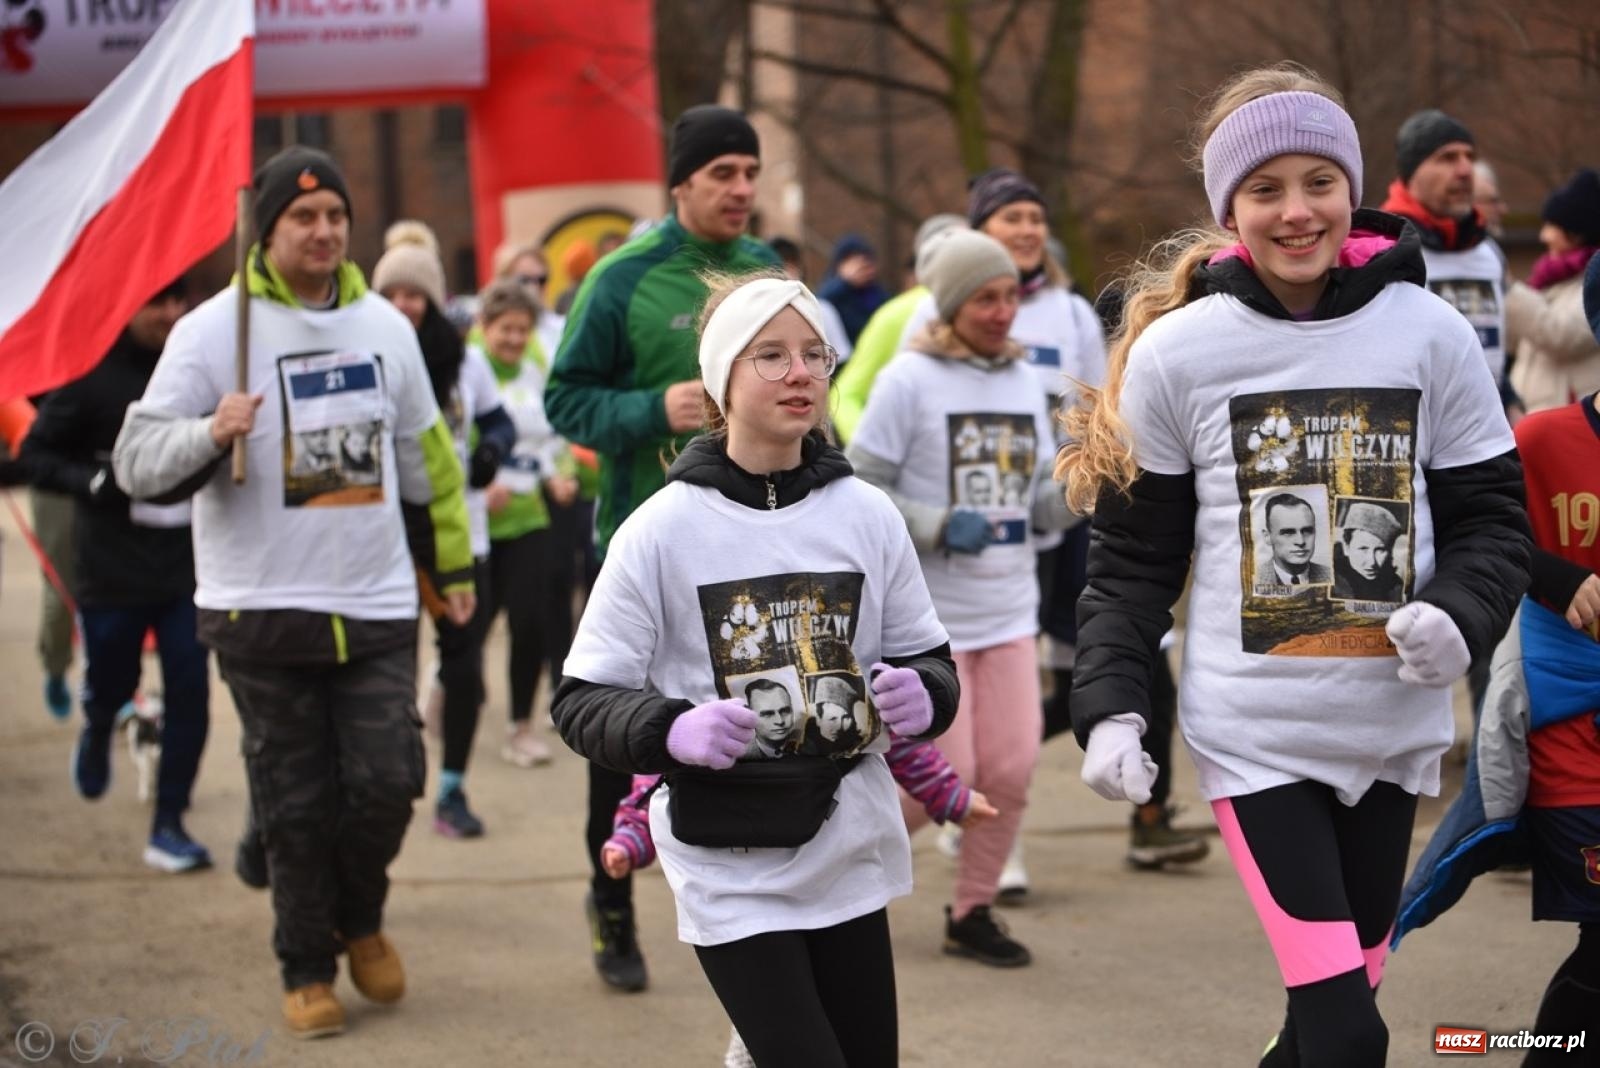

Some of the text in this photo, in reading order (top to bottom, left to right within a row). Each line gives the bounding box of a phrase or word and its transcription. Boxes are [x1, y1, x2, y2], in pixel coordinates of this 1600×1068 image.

[325, 369, 346, 390] 21
[1303, 415, 1361, 432] TROPEM
[1304, 433, 1411, 460] WILCZYM
[1551, 492, 1600, 547] 19
[768, 598, 819, 618] TROPEM
